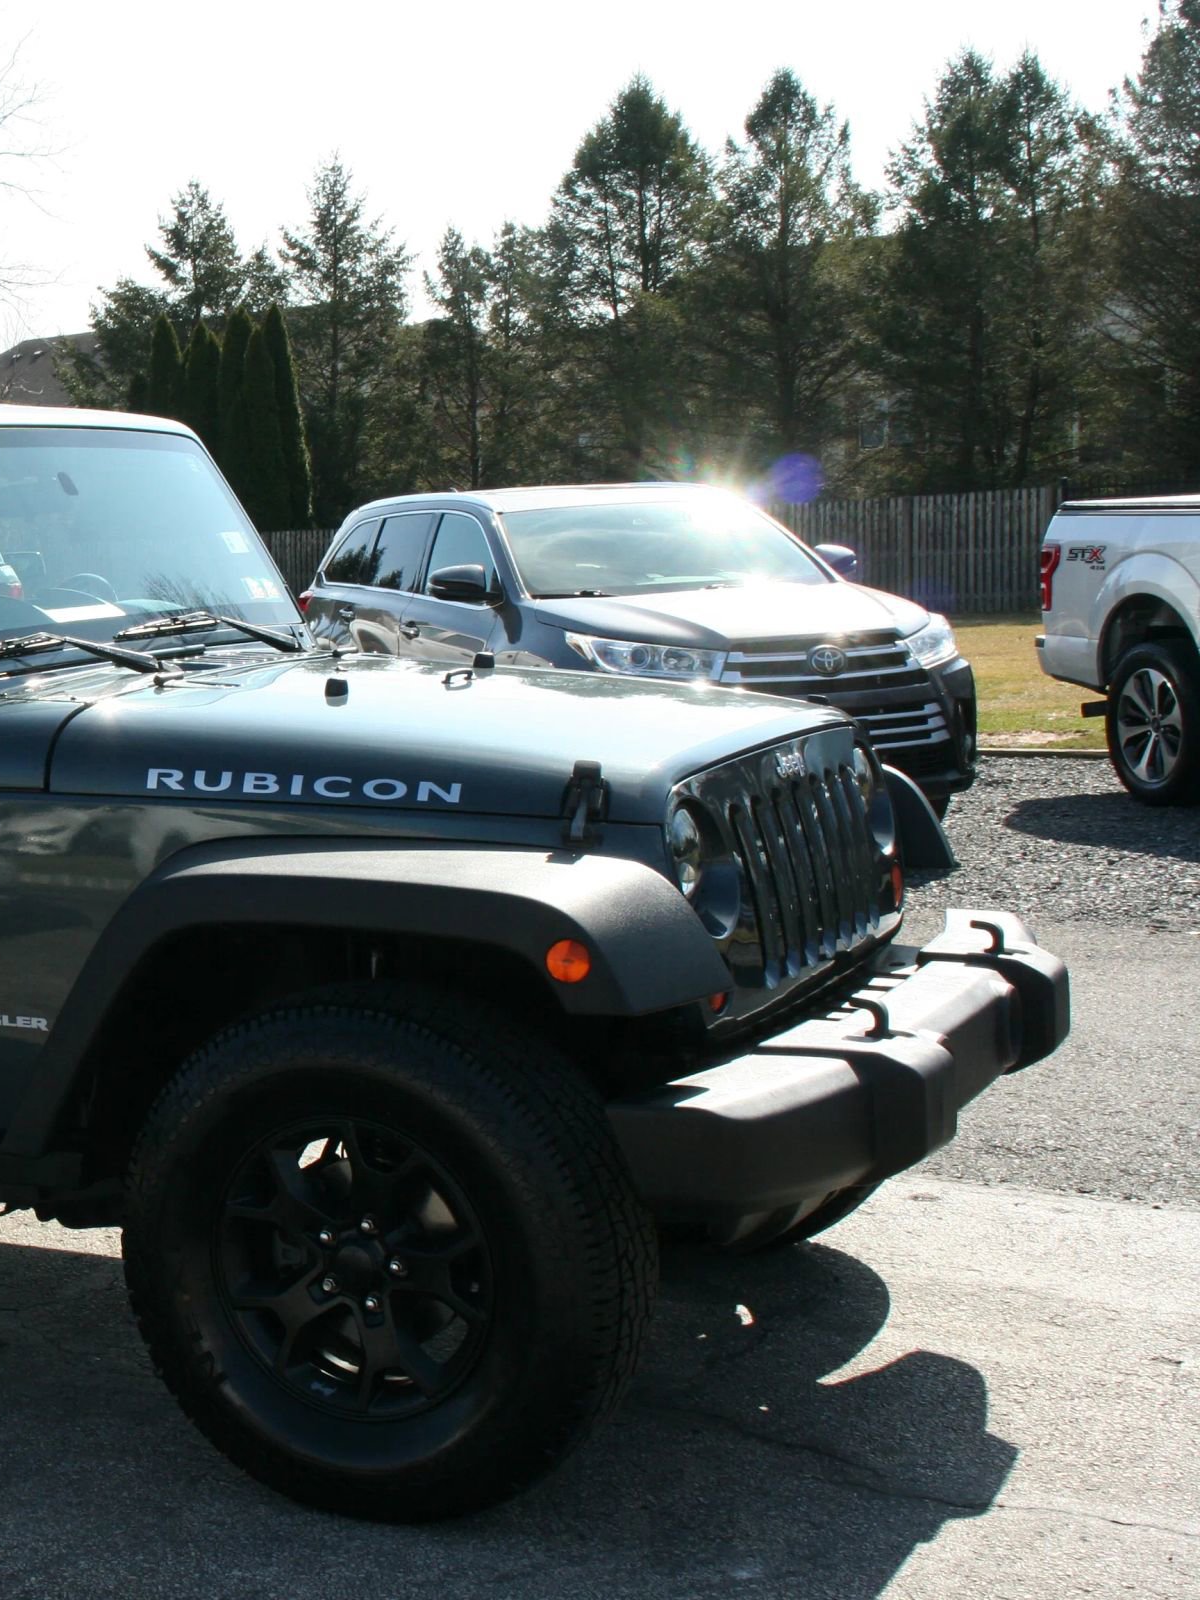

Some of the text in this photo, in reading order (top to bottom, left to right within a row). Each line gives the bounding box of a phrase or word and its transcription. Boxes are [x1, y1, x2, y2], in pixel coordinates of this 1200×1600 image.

[1066, 545, 1107, 564] STX
[775, 752, 806, 778] Jeep
[146, 768, 462, 803] RUBICON
